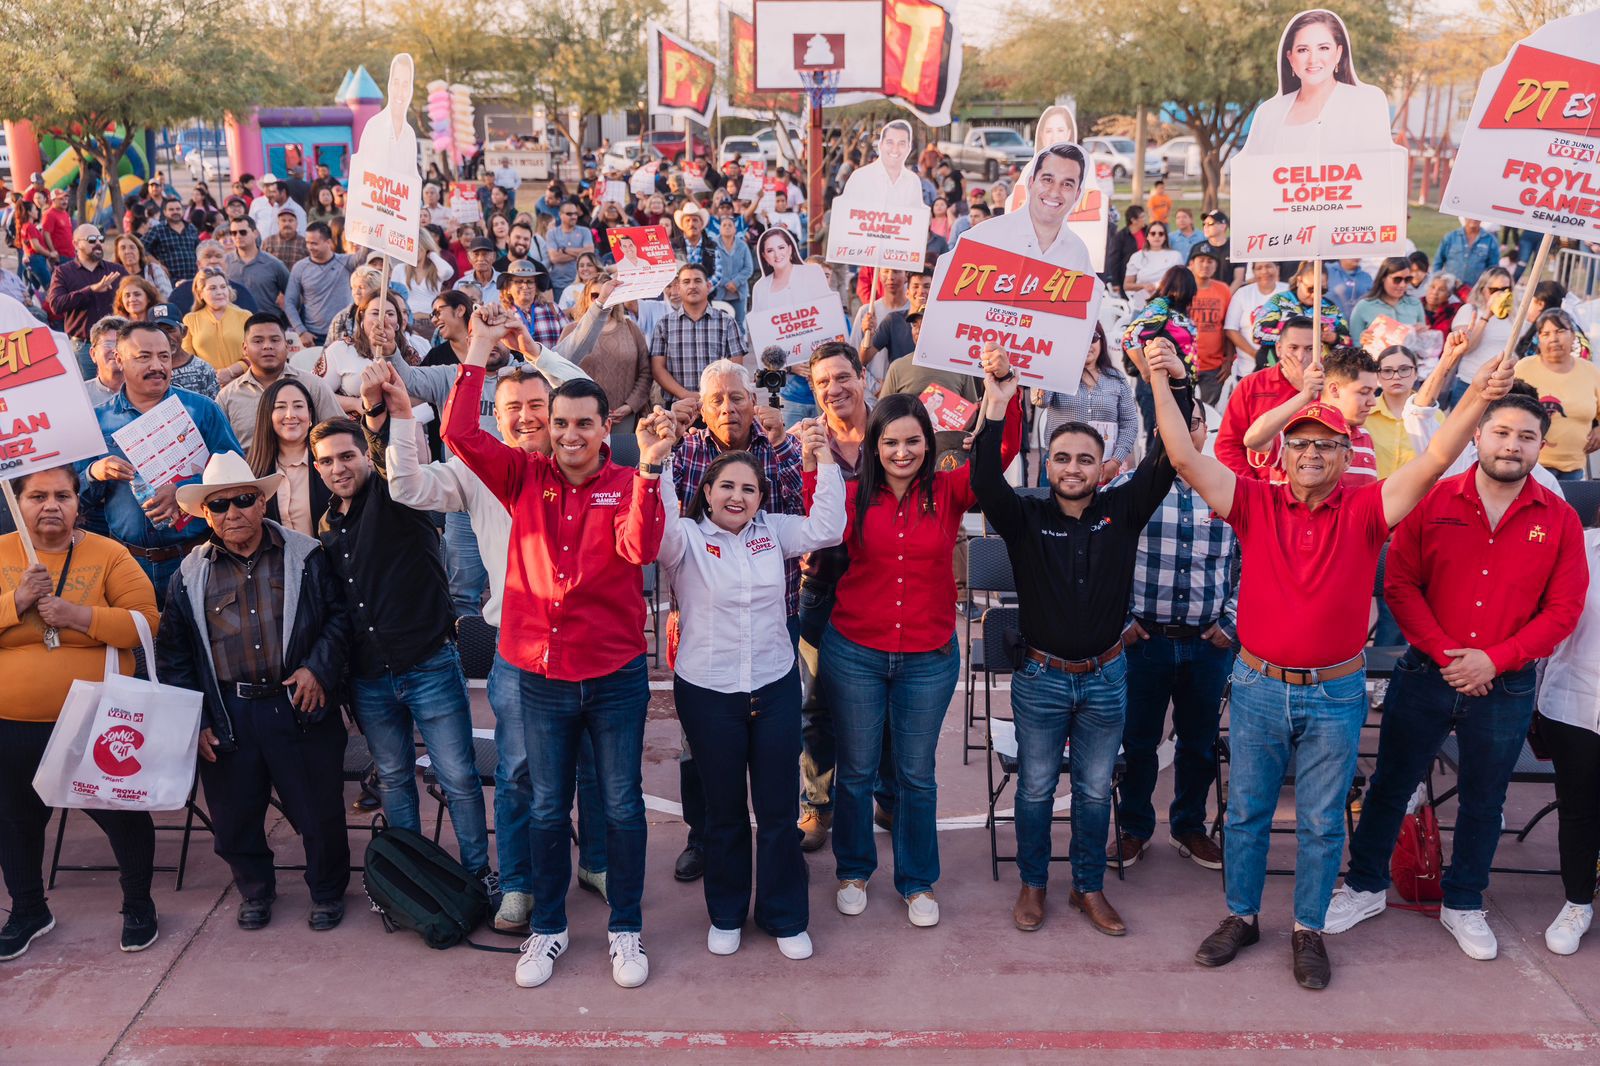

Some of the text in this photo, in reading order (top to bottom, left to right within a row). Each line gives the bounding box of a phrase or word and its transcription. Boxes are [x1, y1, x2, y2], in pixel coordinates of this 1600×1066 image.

[1504, 78, 1596, 123] PT ES
[1559, 139, 1571, 147] DE
[1571, 141, 1594, 150] JUNIO
[1550, 145, 1592, 162] VOTA
[1273, 163, 1363, 184] CELIDA
[1502, 159, 1600, 195] FROYL
[363, 171, 409, 200] FROYLAN
[1282, 183, 1353, 203] LÓPEZ
[1291, 203, 1344, 212] SENADORA
[849, 209, 913, 226] FROYLAN
[1532, 210, 1586, 227] SENADOR
[1247, 225, 1316, 253] PT ES LA 4T
[1332, 232, 1375, 244] VOTA
[1381, 231, 1396, 241] PT
[884, 252, 908, 261] VOTA
[954, 263, 1085, 302] PT ES LA 4T
[771, 306, 820, 325] CELIDA
[987, 312, 1017, 325] VOTA
[1020, 318, 1031, 327] PT
[778, 317, 816, 335] LÓPEZ
[785, 329, 813, 339] SENADORA
[955, 323, 1053, 356] FROYLAN
[792, 342, 803, 356] 4T
[968, 345, 1033, 369] GEZ
[0, 412, 51, 441] LAN
[543, 490, 558, 502] PT
[746, 536, 771, 549] CELIDA
[1528, 530, 1545, 543] PT
[109, 710, 130, 720] VOTA
[101, 729, 135, 745] SOMOS
[118, 746, 131, 757] 4T
[72, 781, 100, 790] CELIDA
[112, 788, 148, 796] FROYLAN
